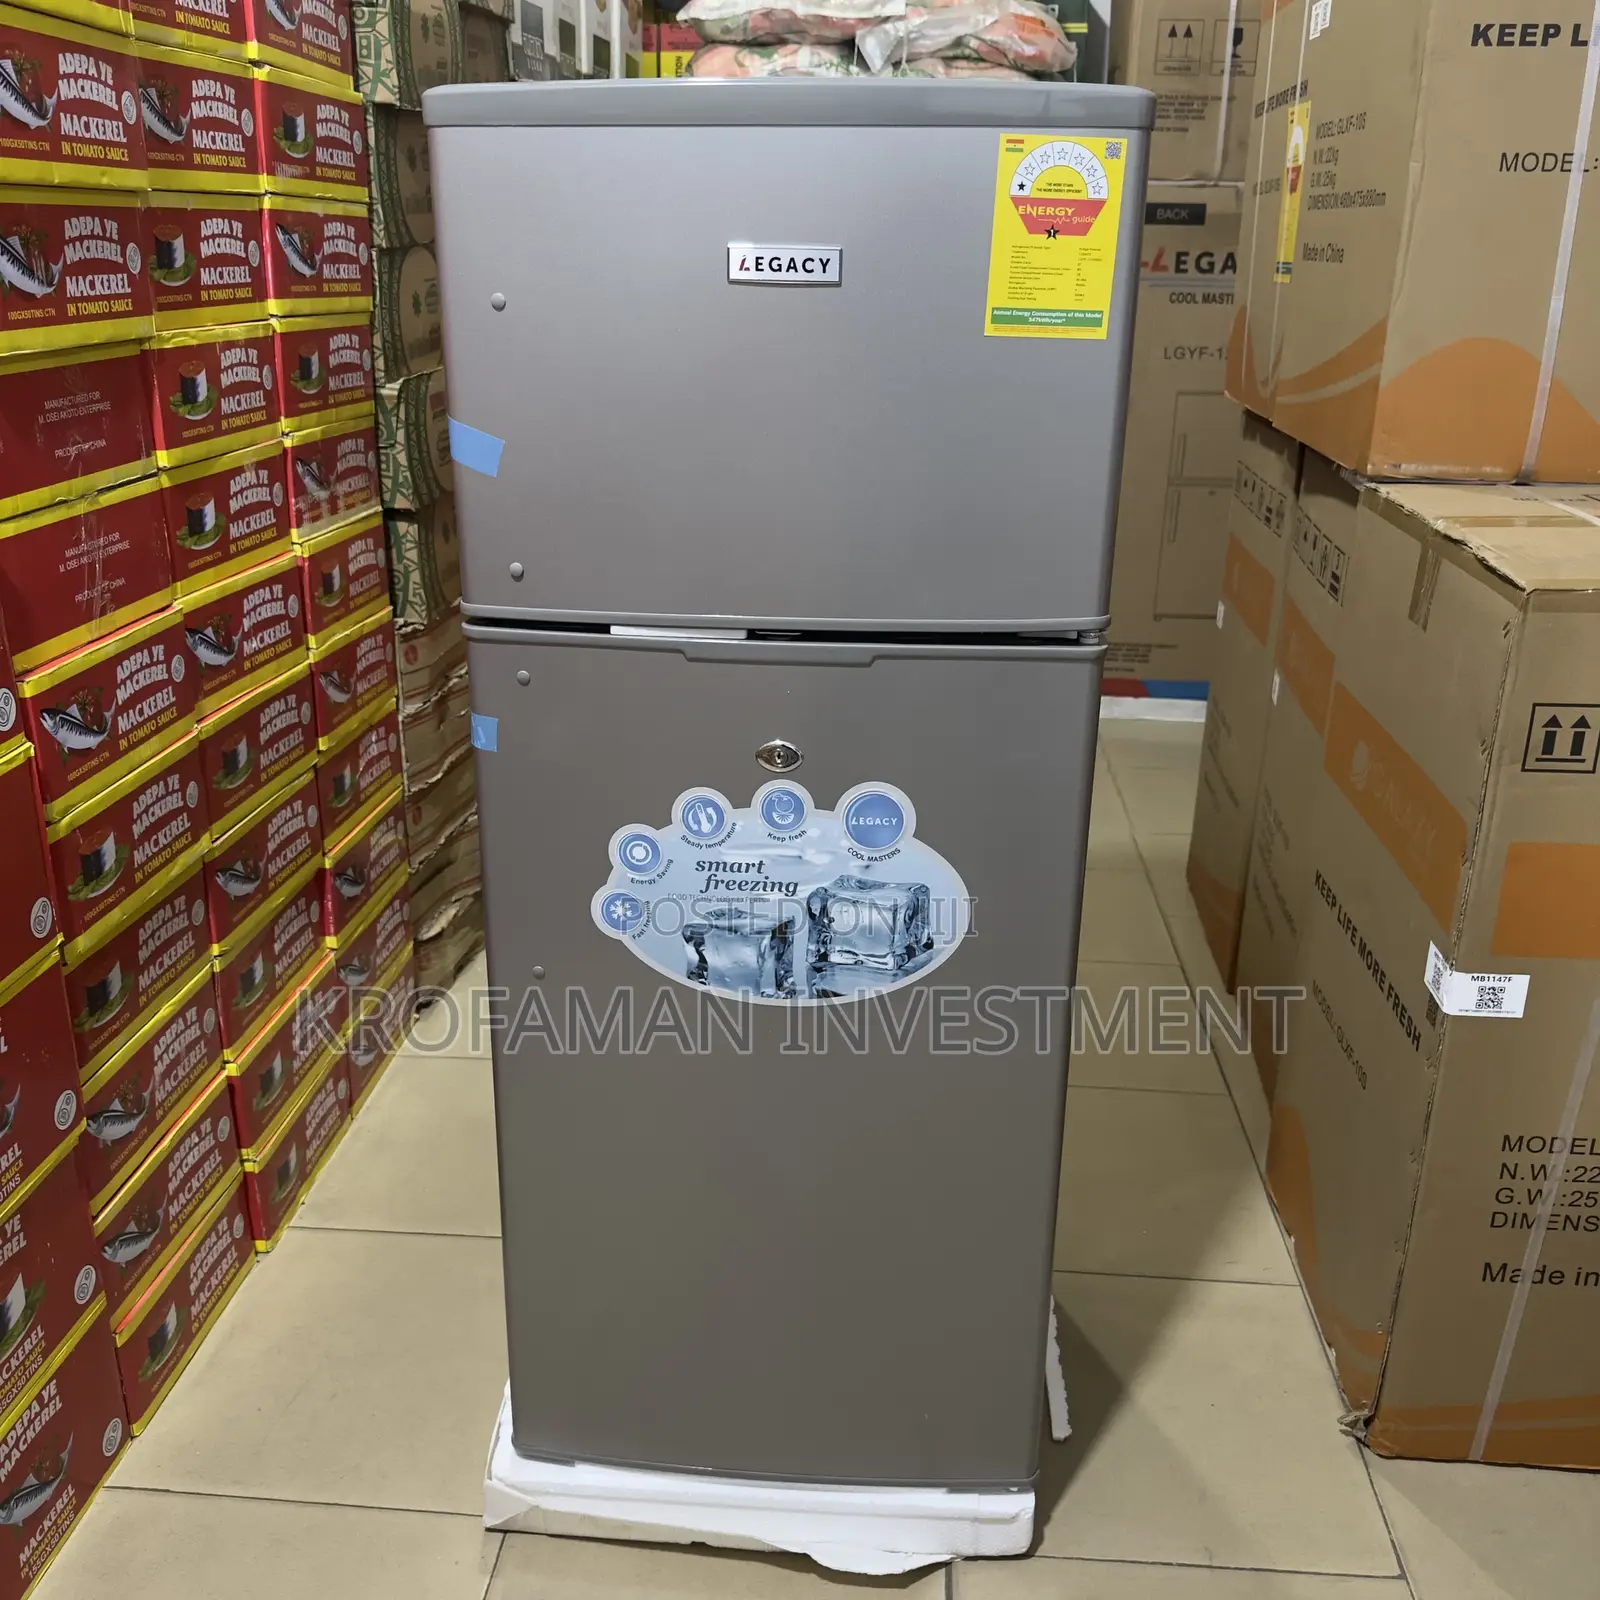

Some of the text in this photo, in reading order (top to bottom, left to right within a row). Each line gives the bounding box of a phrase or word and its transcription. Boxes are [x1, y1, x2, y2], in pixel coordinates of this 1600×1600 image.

[1470, 23, 1562, 47] KEEP
[58, 52, 113, 86] ADEPA YE
[58, 78, 118, 111] MACKEREL
[192, 79, 236, 105] ADEPA YE
[191, 100, 239, 126] MACKEREL
[60, 112, 127, 142] MACKEREL
[61, 141, 129, 161] IN TOMATO SAUCE
[192, 129, 245, 152] MACKEREL
[193, 153, 246, 167] IN TOMATO SAUCE
[1018, 204, 1075, 218] ENERGY
[1072, 215, 1095, 224] guide
[1156, 208, 1190, 220] BACK
[64, 216, 118, 240] ADEPA YE
[200, 218, 243, 238] ADEPA YE
[64, 240, 123, 264] MACKEREL
[200, 237, 246, 259] MACKEREL
[200, 265, 251, 286] MACKEREL
[739, 255, 831, 274] LEGACY
[65, 273, 131, 298] MACKEREL
[201, 287, 252, 302] IN TOMATO SAUCE
[67, 299, 133, 316] IN TOMATO SAUCE
[1169, 292, 1199, 305] COOL
[220, 348, 258, 369] ADEPA YE
[1163, 346, 1229, 361] LGYF-1
[220, 366, 261, 389] MACKEREL
[89, 391, 101, 401] FOR
[221, 390, 266, 415] MACKEREL
[221, 410, 267, 430] IN TOMATO SAUCE
[109, 532, 120, 542] FOR
[116, 644, 164, 684] ADEPA YE
[116, 663, 168, 706] MACKEREL
[117, 685, 176, 735] MACKEREL
[119, 706, 178, 751] IN TOMATO SAUCE
[132, 773, 179, 820] ADEPA YE
[132, 792, 184, 840] MACKEREL
[851, 817, 898, 826] LEGACY
[133, 812, 191, 868] MACKEREL
[680, 822, 737, 850] Steady temperature
[767, 829, 807, 843] Keep fresh
[847, 847, 901, 862] COOL MASTERS
[630, 858, 674, 886] Energy Saving
[694, 860, 766, 875] smart
[699, 874, 799, 898] freezing
[1315, 868, 1421, 1052] KEEP LIFE MORE FRESH
[1471, 975, 1513, 983] MB1147F
[1489, 1211, 1600, 1232] DIMENS
[1481, 1262, 1600, 1287] Made in
[0, 1379, 57, 1460] ADEPA YE
[0, 1395, 63, 1484] MACKEREL
[19, 1483, 76, 1568] MACKEREL
